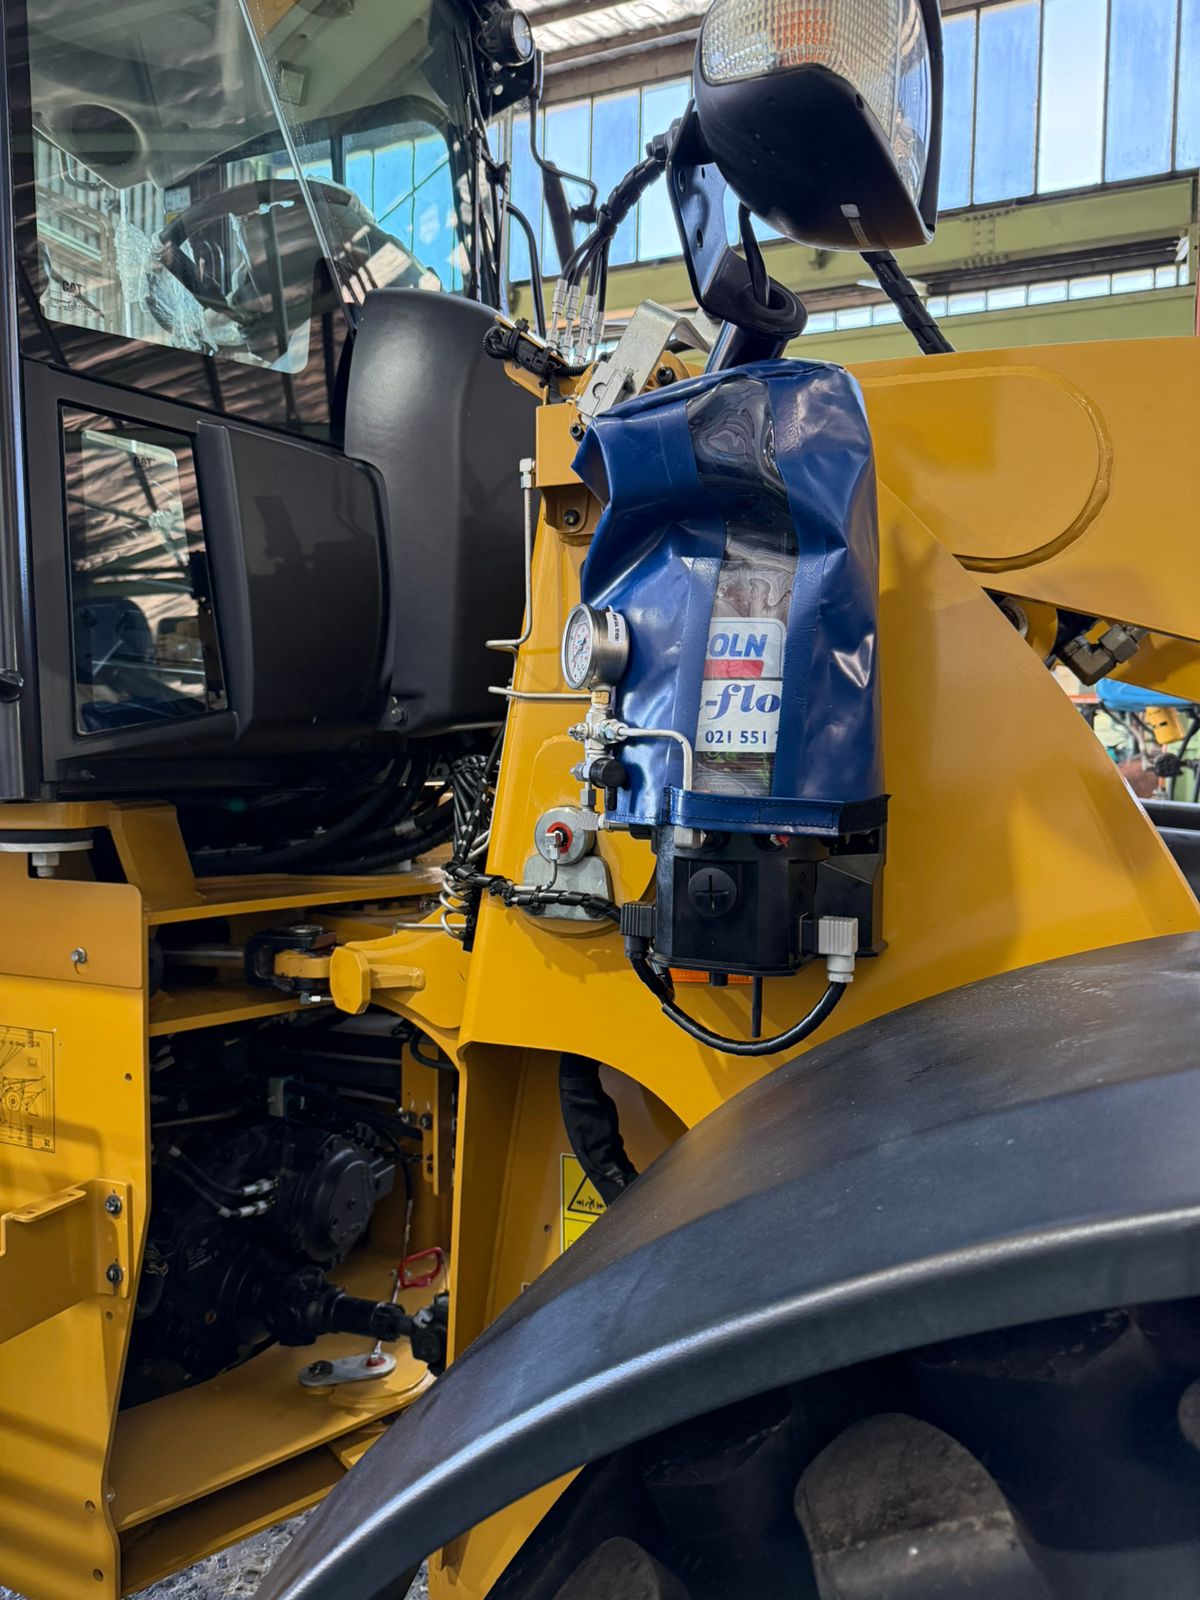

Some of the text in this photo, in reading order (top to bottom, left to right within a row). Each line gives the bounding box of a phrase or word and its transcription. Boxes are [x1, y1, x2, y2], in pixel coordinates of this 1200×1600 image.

[62, 280, 83, 294] CAT
[708, 632, 768, 658] OLN
[701, 683, 781, 720] -flo
[705, 730, 767, 744] 021 551
